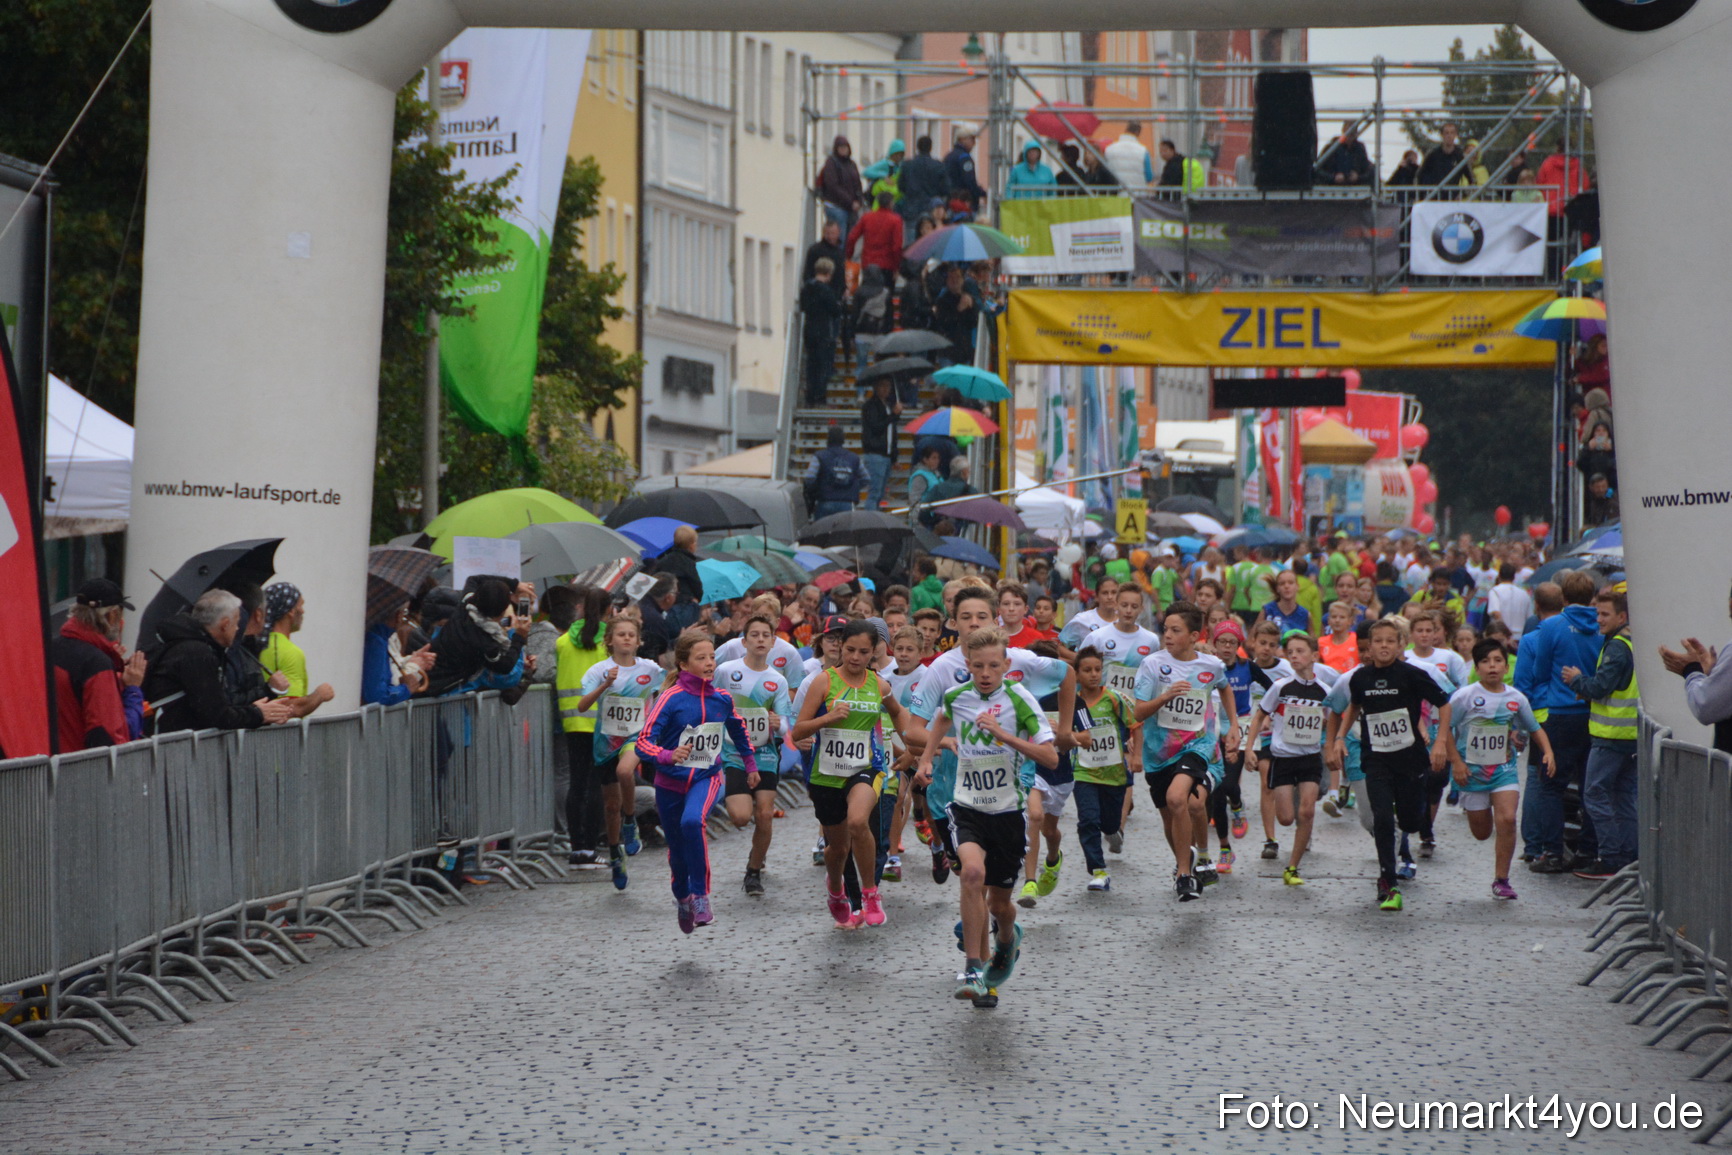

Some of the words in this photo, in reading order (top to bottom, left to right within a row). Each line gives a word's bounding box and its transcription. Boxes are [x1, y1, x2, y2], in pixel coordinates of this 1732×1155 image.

[1140, 219, 1228, 241] BOCK
[1068, 245, 1124, 257] NeuerMarkt
[1036, 327, 1098, 339] Neumarkter
[1103, 329, 1152, 341] Stadtlauf
[1219, 307, 1341, 349] ZIEL
[144, 480, 341, 505] www.bmw-laufsport.de
[1120, 501, 1143, 510] Block
[1123, 512, 1139, 533] A
[1110, 674, 1135, 690] 410
[1364, 688, 1399, 696] STANNO
[607, 706, 641, 722] 4037
[1164, 697, 1204, 715] 4052
[1171, 716, 1193, 725] Morris
[1287, 715, 1321, 730] 4042
[1373, 718, 1408, 737] 4043
[684, 733, 719, 751] 4019
[825, 740, 865, 760] 4040
[1083, 736, 1116, 753] 049
[1470, 735, 1505, 750] 4109
[962, 767, 1008, 791] 4002
[972, 796, 998, 805] Niklas
